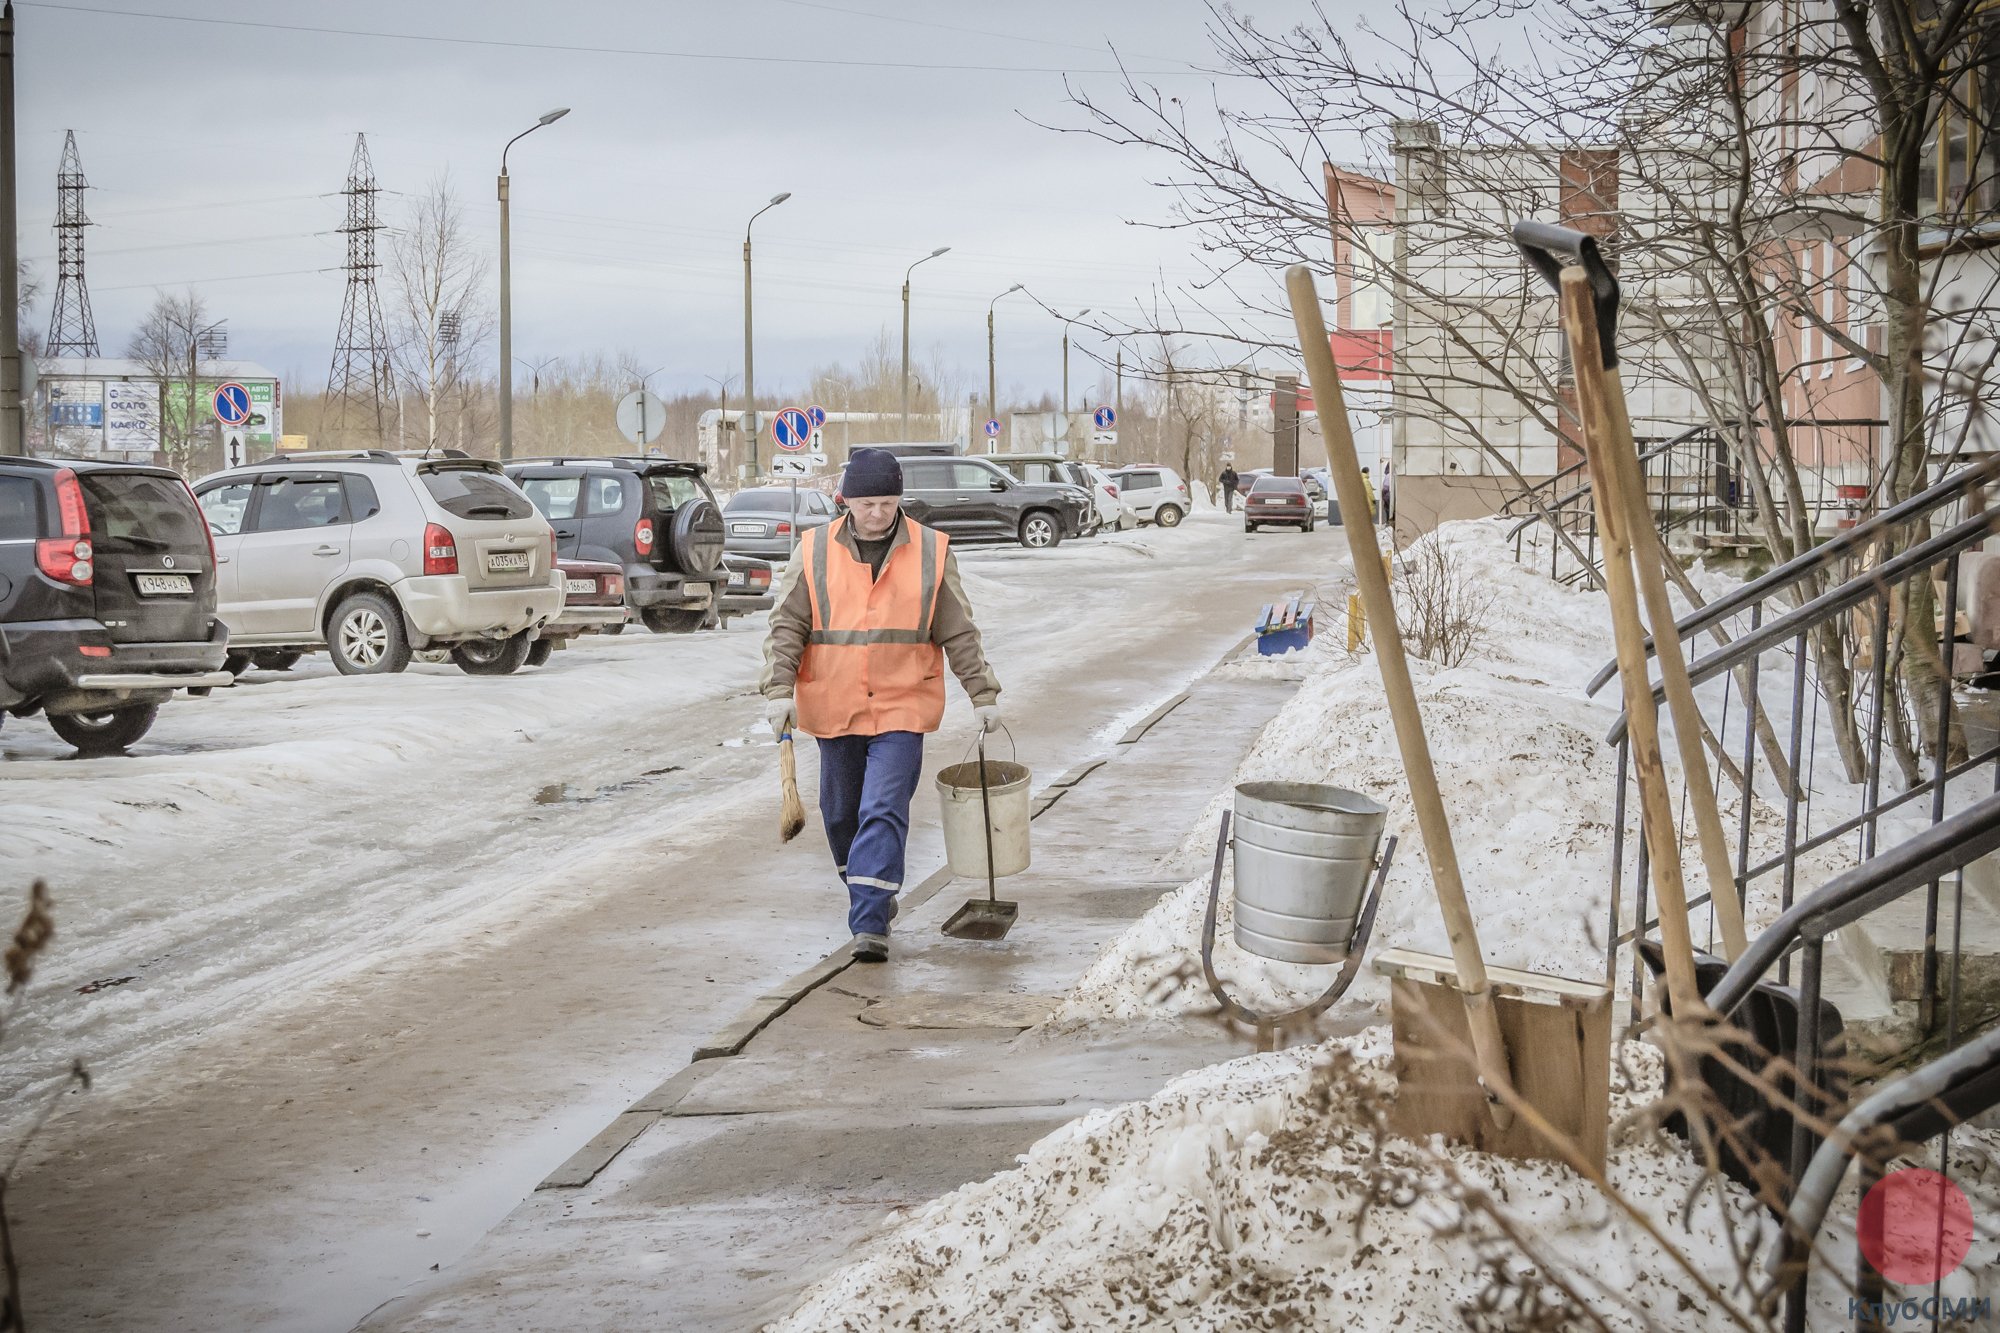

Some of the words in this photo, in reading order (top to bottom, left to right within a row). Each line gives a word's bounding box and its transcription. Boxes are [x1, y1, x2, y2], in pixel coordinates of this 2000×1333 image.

[110, 421, 146, 429] КАСКО
[491, 555, 518, 568] А035КА
[142, 577, 179, 591] К948НА
